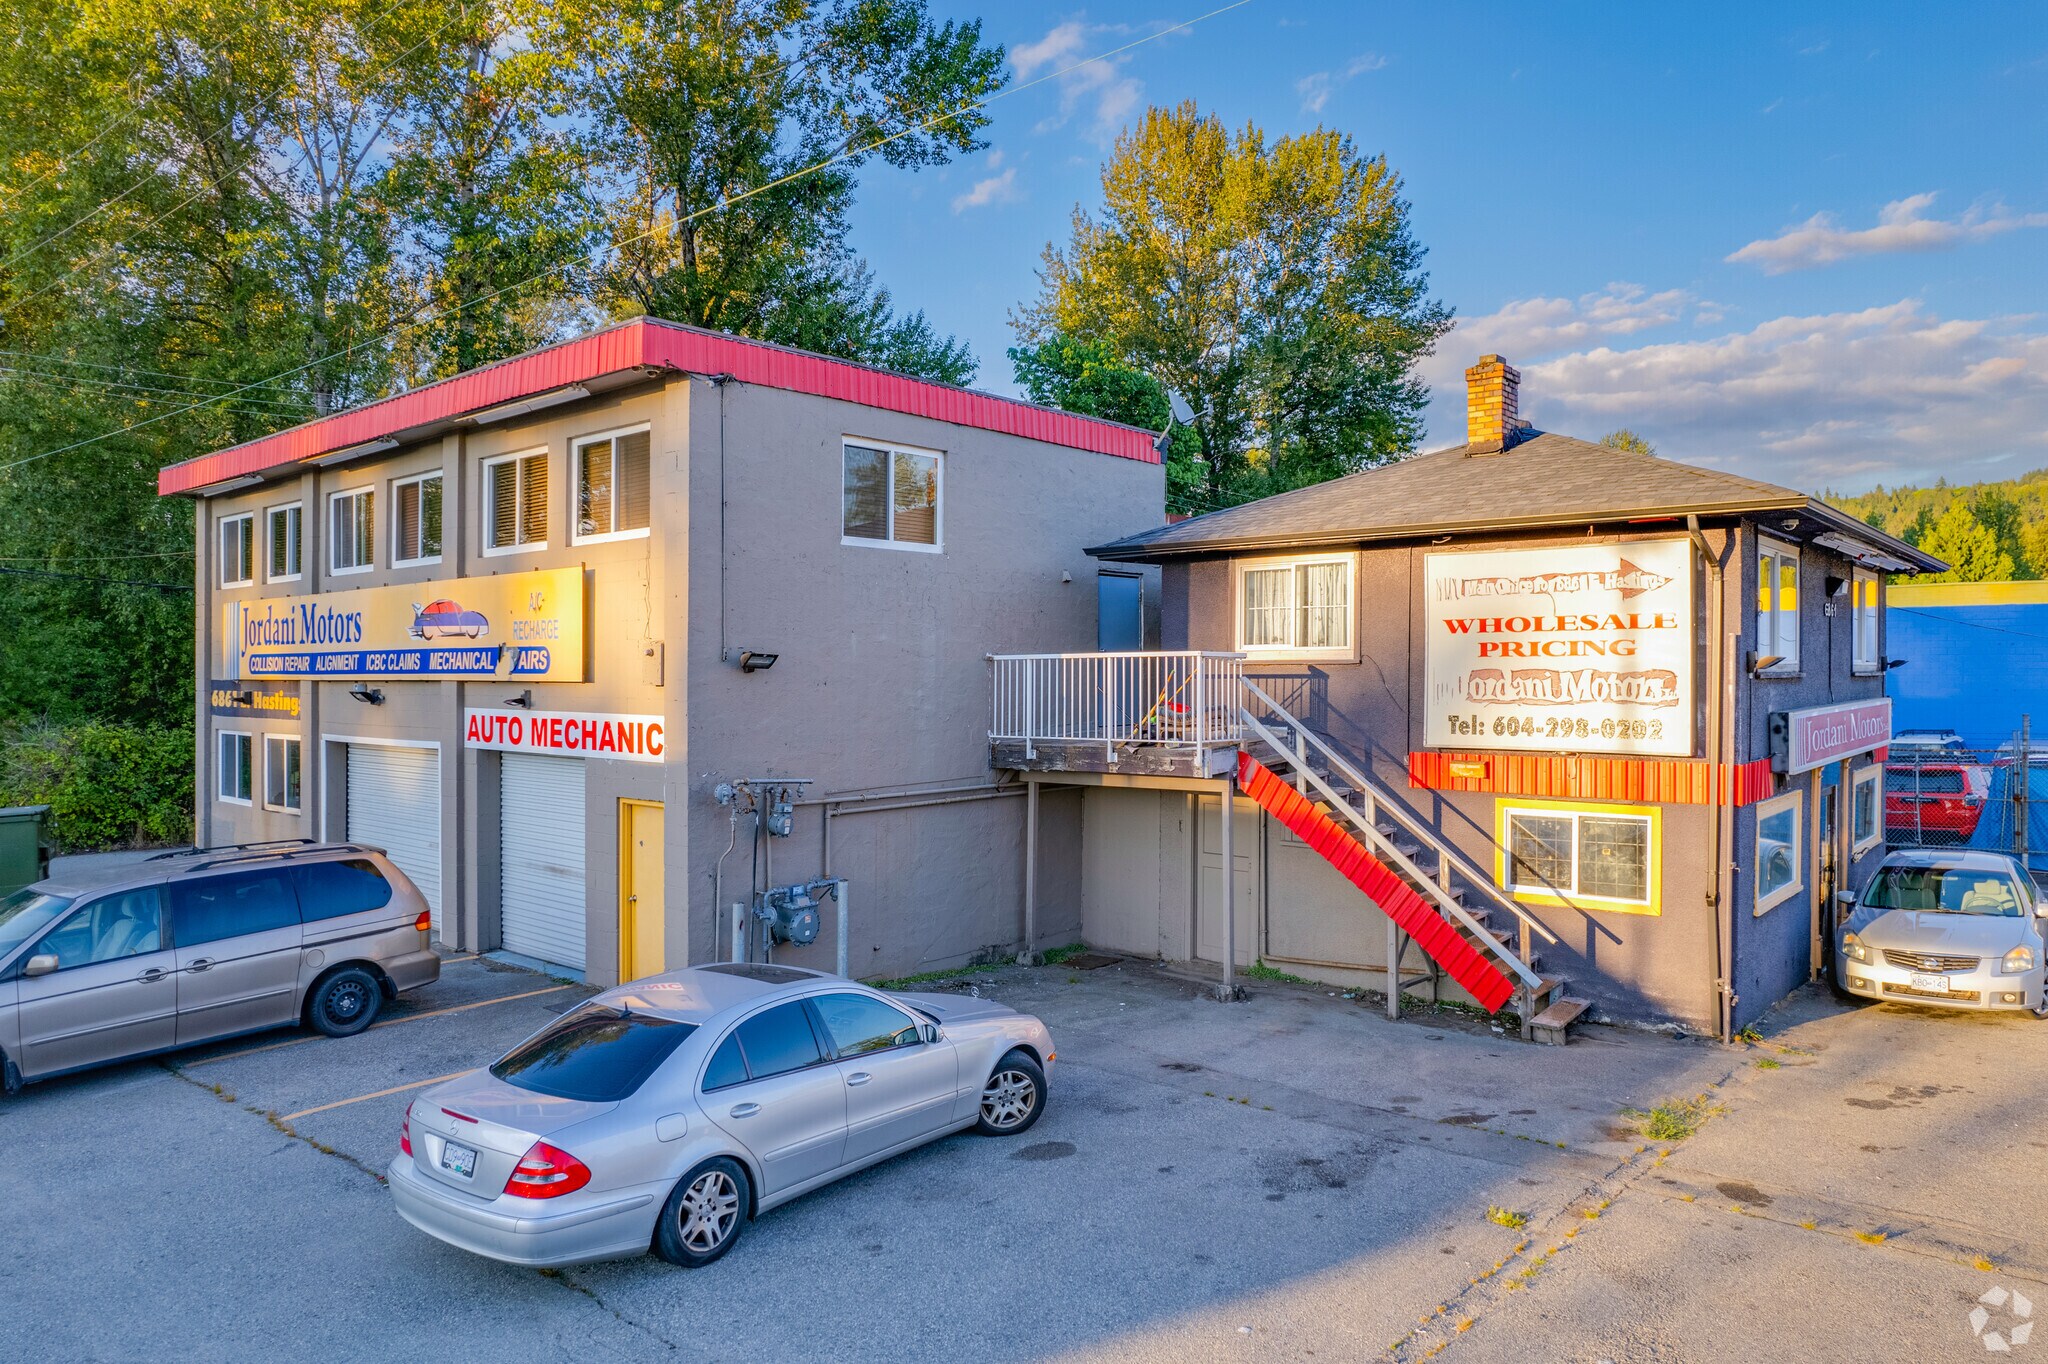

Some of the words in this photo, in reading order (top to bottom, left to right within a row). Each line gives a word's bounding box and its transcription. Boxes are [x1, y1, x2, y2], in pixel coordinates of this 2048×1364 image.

[241, 605, 296, 657] Jordani
[300, 603, 362, 645] Motors
[513, 619, 559, 640] RECHARGE
[1443, 612, 1678, 634] WHOLESALE
[1478, 639, 1638, 658] PRICING
[250, 656, 284, 672] COLLISION
[284, 656, 310, 672] REPAIR
[315, 654, 359, 671] ALIGNMENT
[366, 654, 386, 671] ICBC
[387, 652, 421, 670] CLAIMS
[429, 651, 494, 670] MECHANICAL
[253, 690, 301, 716] Hasting
[467, 714, 523, 745] AUTO
[531, 717, 664, 755] MECHANIC
[1448, 714, 1485, 736] Tel:
[1807, 716, 1848, 760] Jordani
[1850, 711, 1884, 741] Motors
